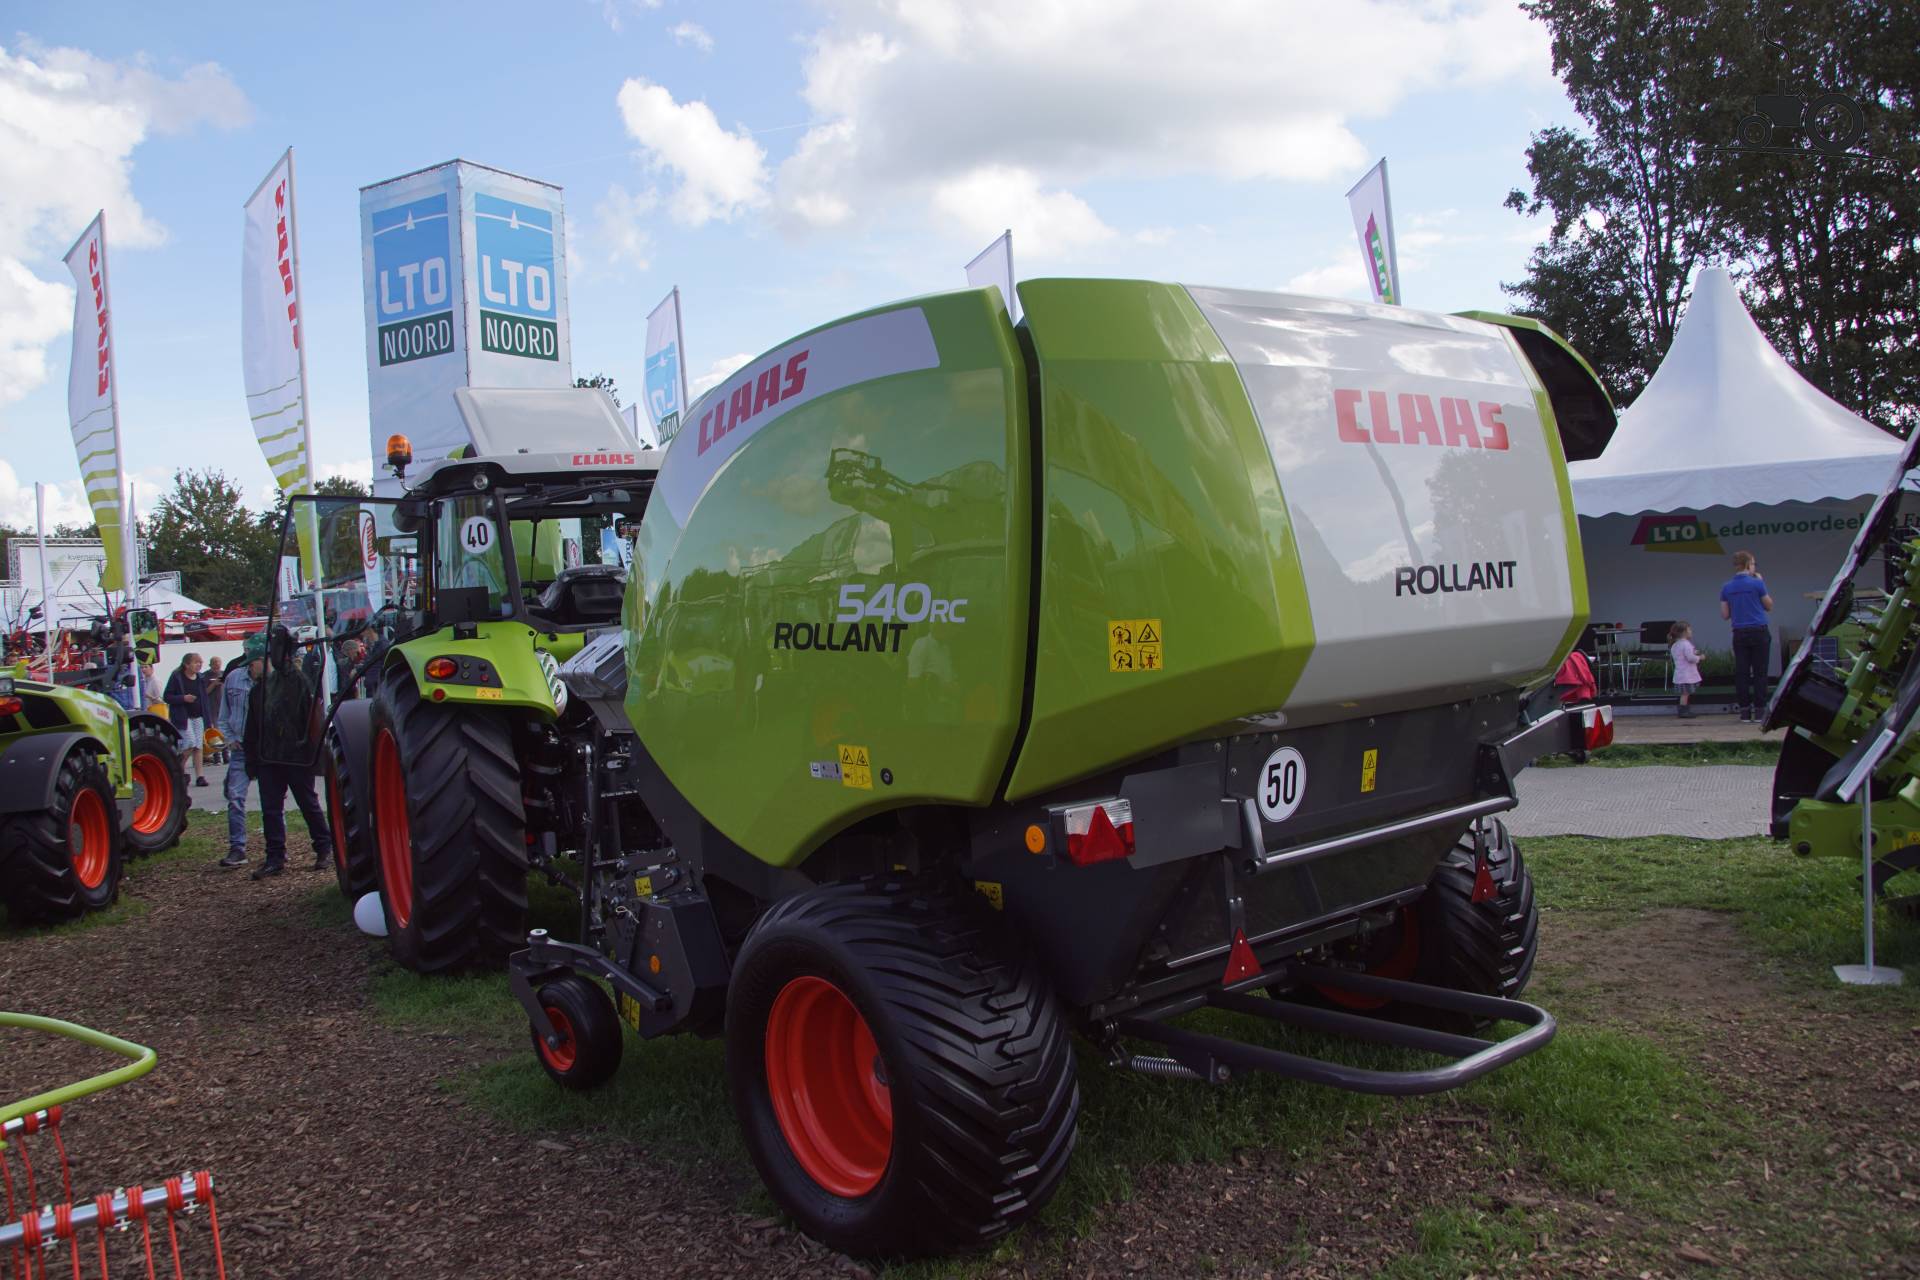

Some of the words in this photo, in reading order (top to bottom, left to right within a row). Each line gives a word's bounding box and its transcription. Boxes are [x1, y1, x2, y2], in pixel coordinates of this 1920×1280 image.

[380, 256, 447, 315] LTO
[482, 254, 551, 312] LTO
[384, 319, 451, 361] NOORD
[486, 317, 555, 356] NOORD
[698, 349, 810, 457] CLAAS
[1334, 388, 1510, 451] CLAAS
[572, 453, 635, 466] CLAAS
[467, 522, 489, 548] 40
[1653, 524, 1697, 542] LTO
[1395, 561, 1517, 597] ROLLANT
[773, 622, 908, 653] ROLLANT
[1266, 759, 1298, 809] 50
